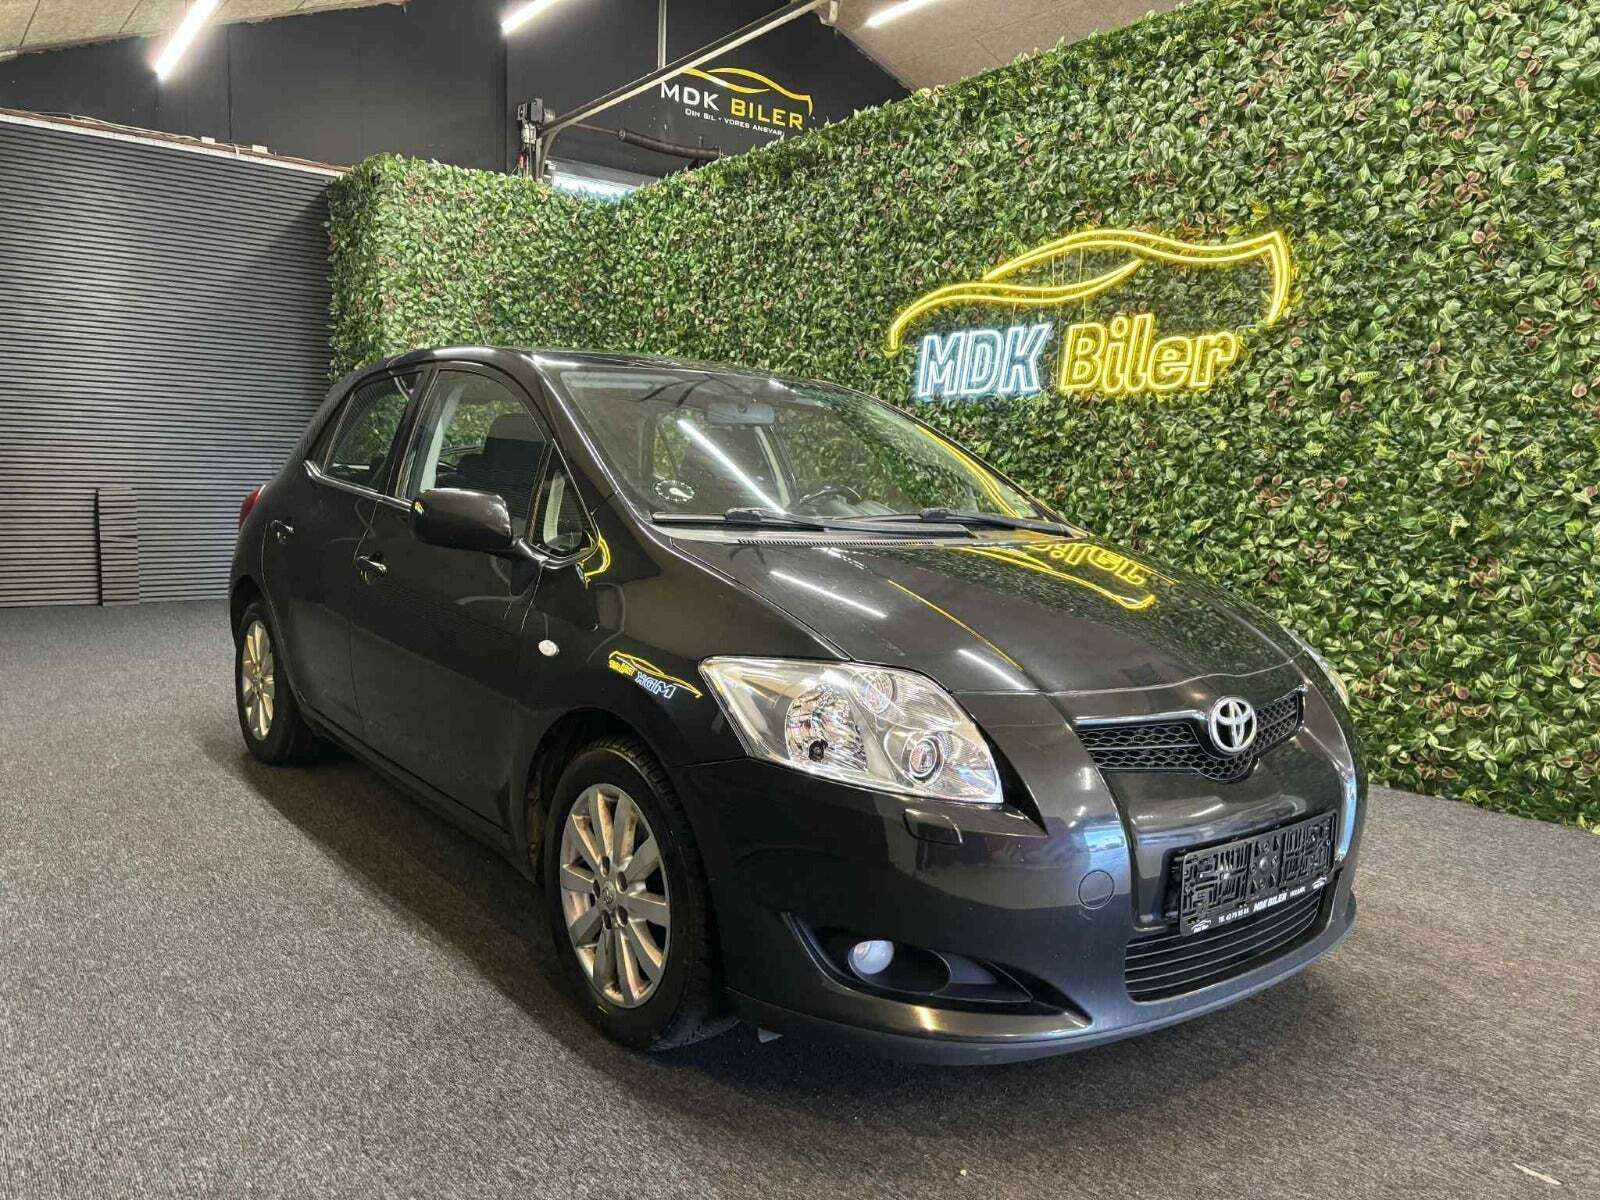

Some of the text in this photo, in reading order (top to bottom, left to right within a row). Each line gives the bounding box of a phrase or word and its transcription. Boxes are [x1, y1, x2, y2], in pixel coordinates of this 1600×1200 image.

[660, 81, 804, 130] MDK BILER
[684, 108, 700, 118] DIN
[703, 113, 716, 121] BIL
[724, 118, 750, 129] VORES
[917, 312, 1239, 398] MDK Biler
